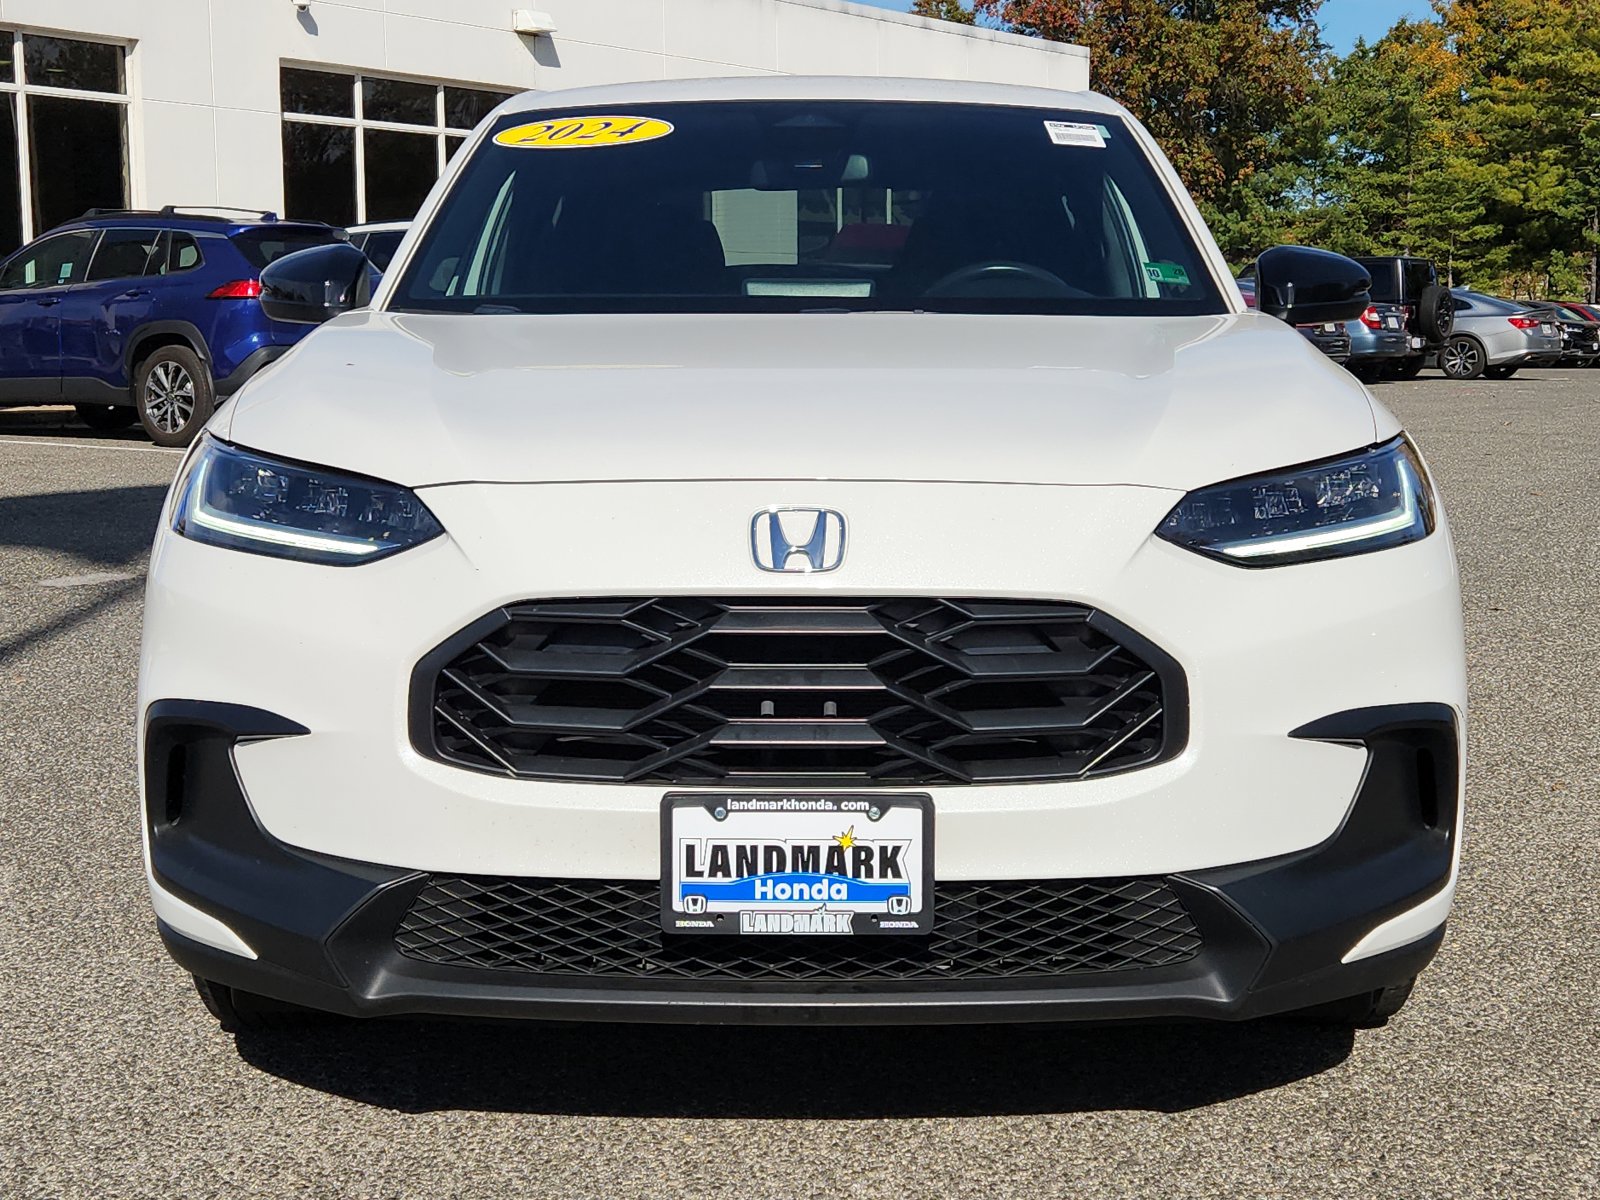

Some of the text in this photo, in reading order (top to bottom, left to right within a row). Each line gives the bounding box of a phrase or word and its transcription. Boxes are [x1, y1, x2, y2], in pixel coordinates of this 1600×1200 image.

[515, 120, 650, 143] 2024
[685, 843, 904, 879] LANDMARK
[754, 879, 848, 901] Honda
[675, 920, 715, 928] HONDA
[742, 913, 851, 933] LANDMARK
[880, 920, 919, 929] HONDA
